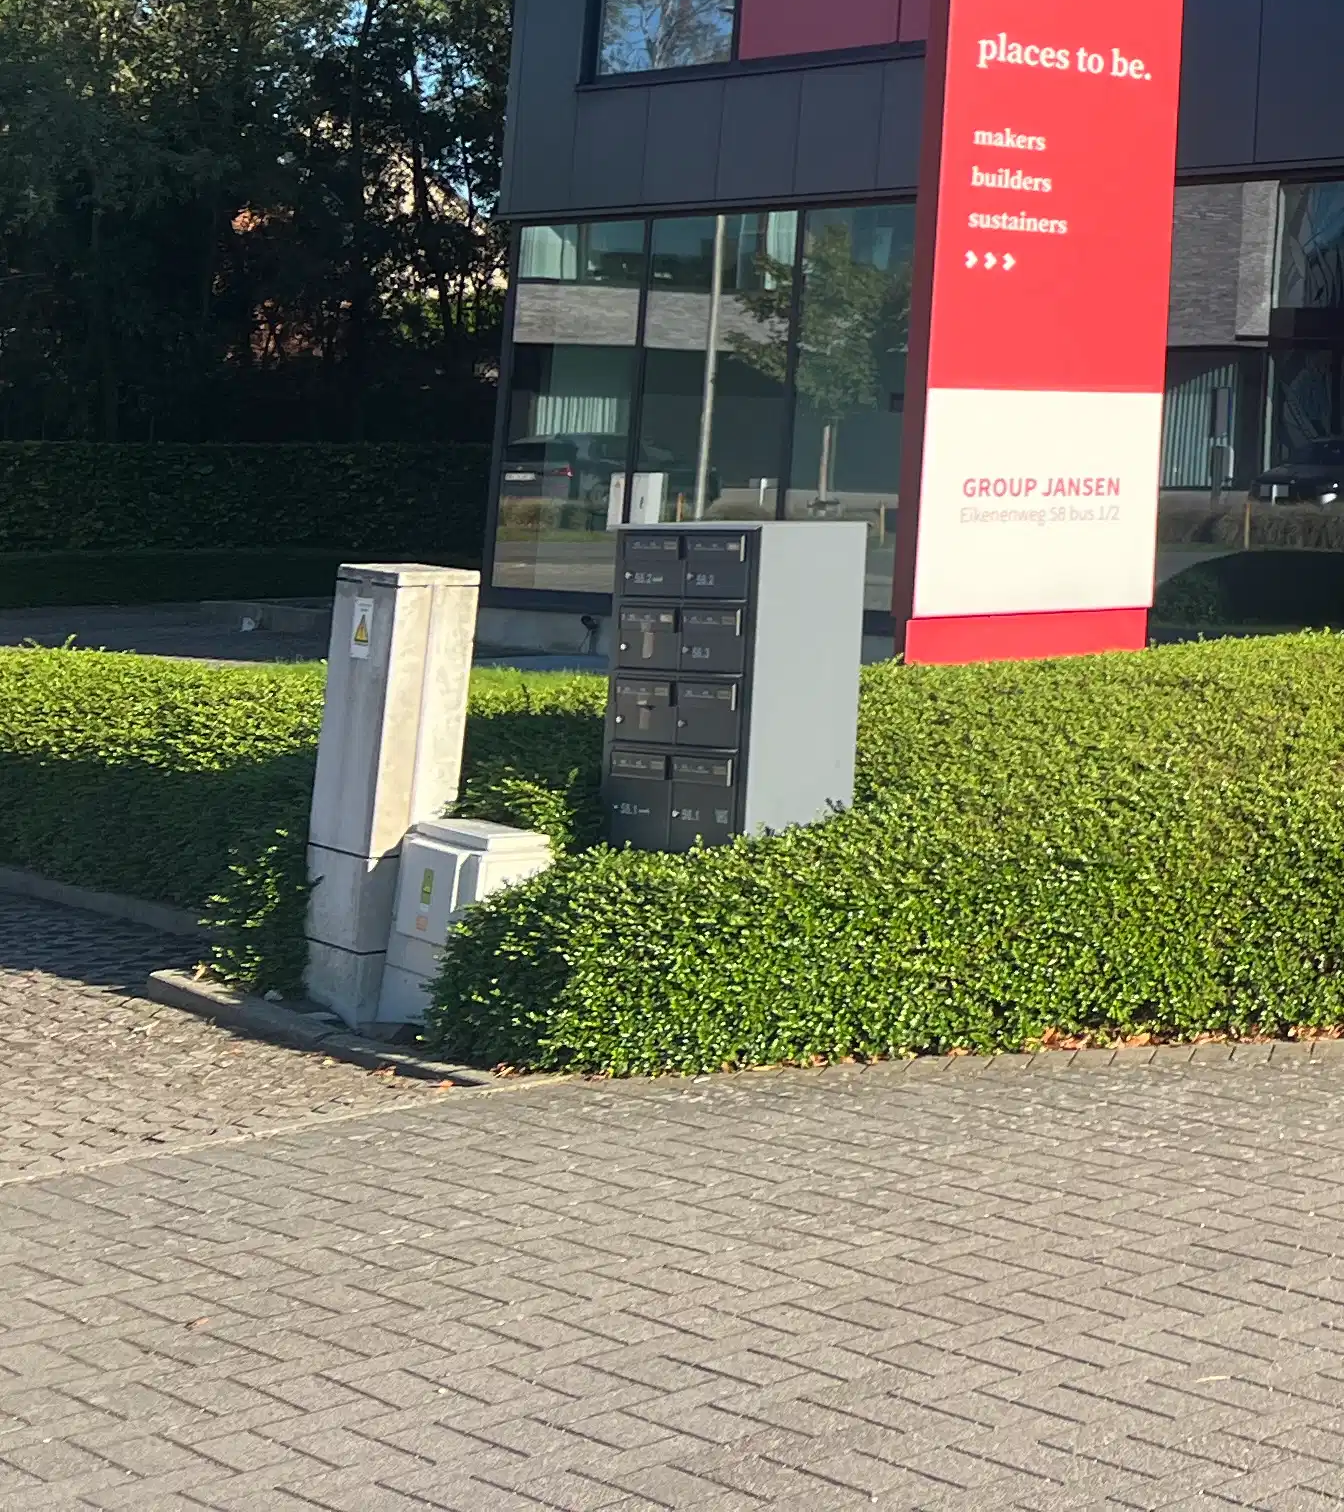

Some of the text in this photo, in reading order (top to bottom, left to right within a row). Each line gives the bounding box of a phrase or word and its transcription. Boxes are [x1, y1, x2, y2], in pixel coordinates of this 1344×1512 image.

[976, 32, 1152, 81] places to be.
[973, 127, 1047, 151] makers
[971, 165, 1052, 193] builders
[967, 211, 1068, 234] sustainers
[963, 477, 1120, 498] GROUP JANSEN
[1069, 504, 1095, 522] bus
[1098, 504, 1120, 522] 1/2
